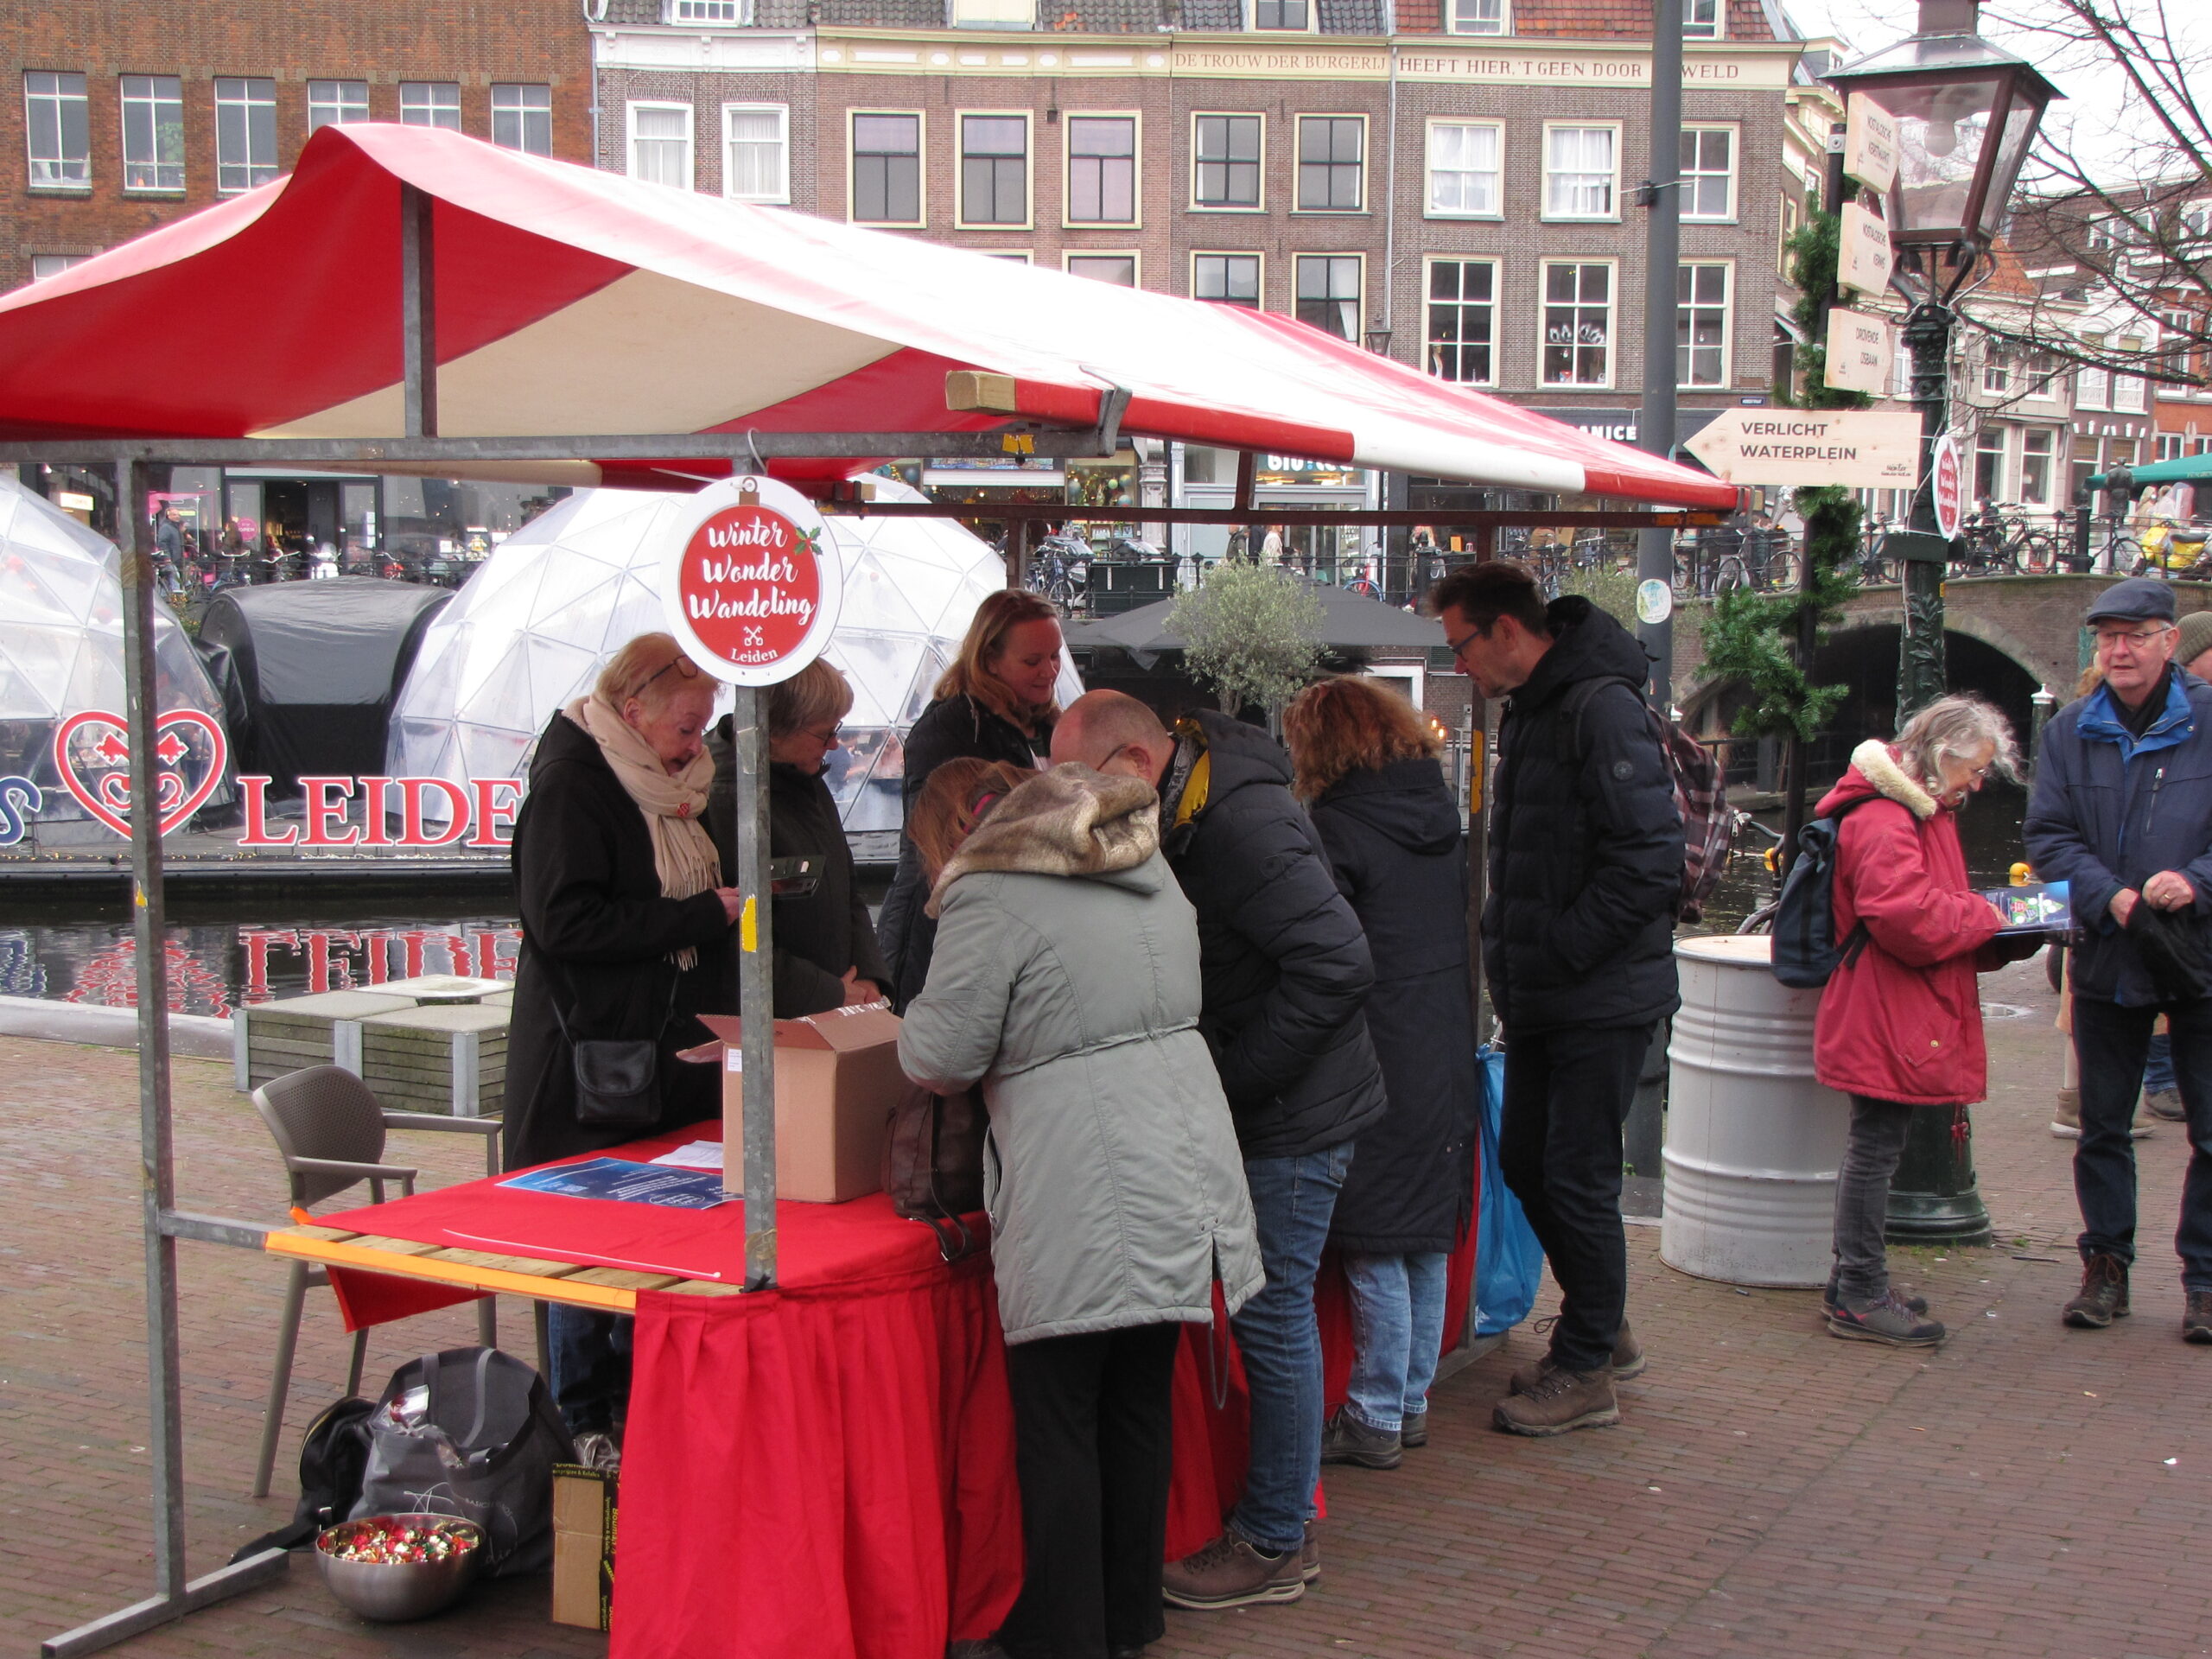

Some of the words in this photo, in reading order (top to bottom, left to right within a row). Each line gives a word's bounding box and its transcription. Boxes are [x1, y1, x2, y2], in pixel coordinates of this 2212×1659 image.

[1175, 53, 1198, 67] DE
[1200, 54, 1263, 68] TROUW
[1267, 55, 1300, 69] DER
[1305, 56, 1386, 71] BURGERIJ
[1399, 57, 1459, 73] HEEFT
[1537, 61, 1585, 77] GEEN
[1592, 62, 1643, 78] DOOR
[1681, 65, 1738, 79] WELD
[1740, 422, 1828, 436] VERLICHT
[1739, 444, 1857, 461] WATERPLEIN
[709, 515, 788, 549] Winter
[702, 551, 799, 584] Wonder
[690, 585, 817, 626] Wandeling
[730, 648, 779, 664] Leiden
[237, 775, 524, 849] LEIDE
